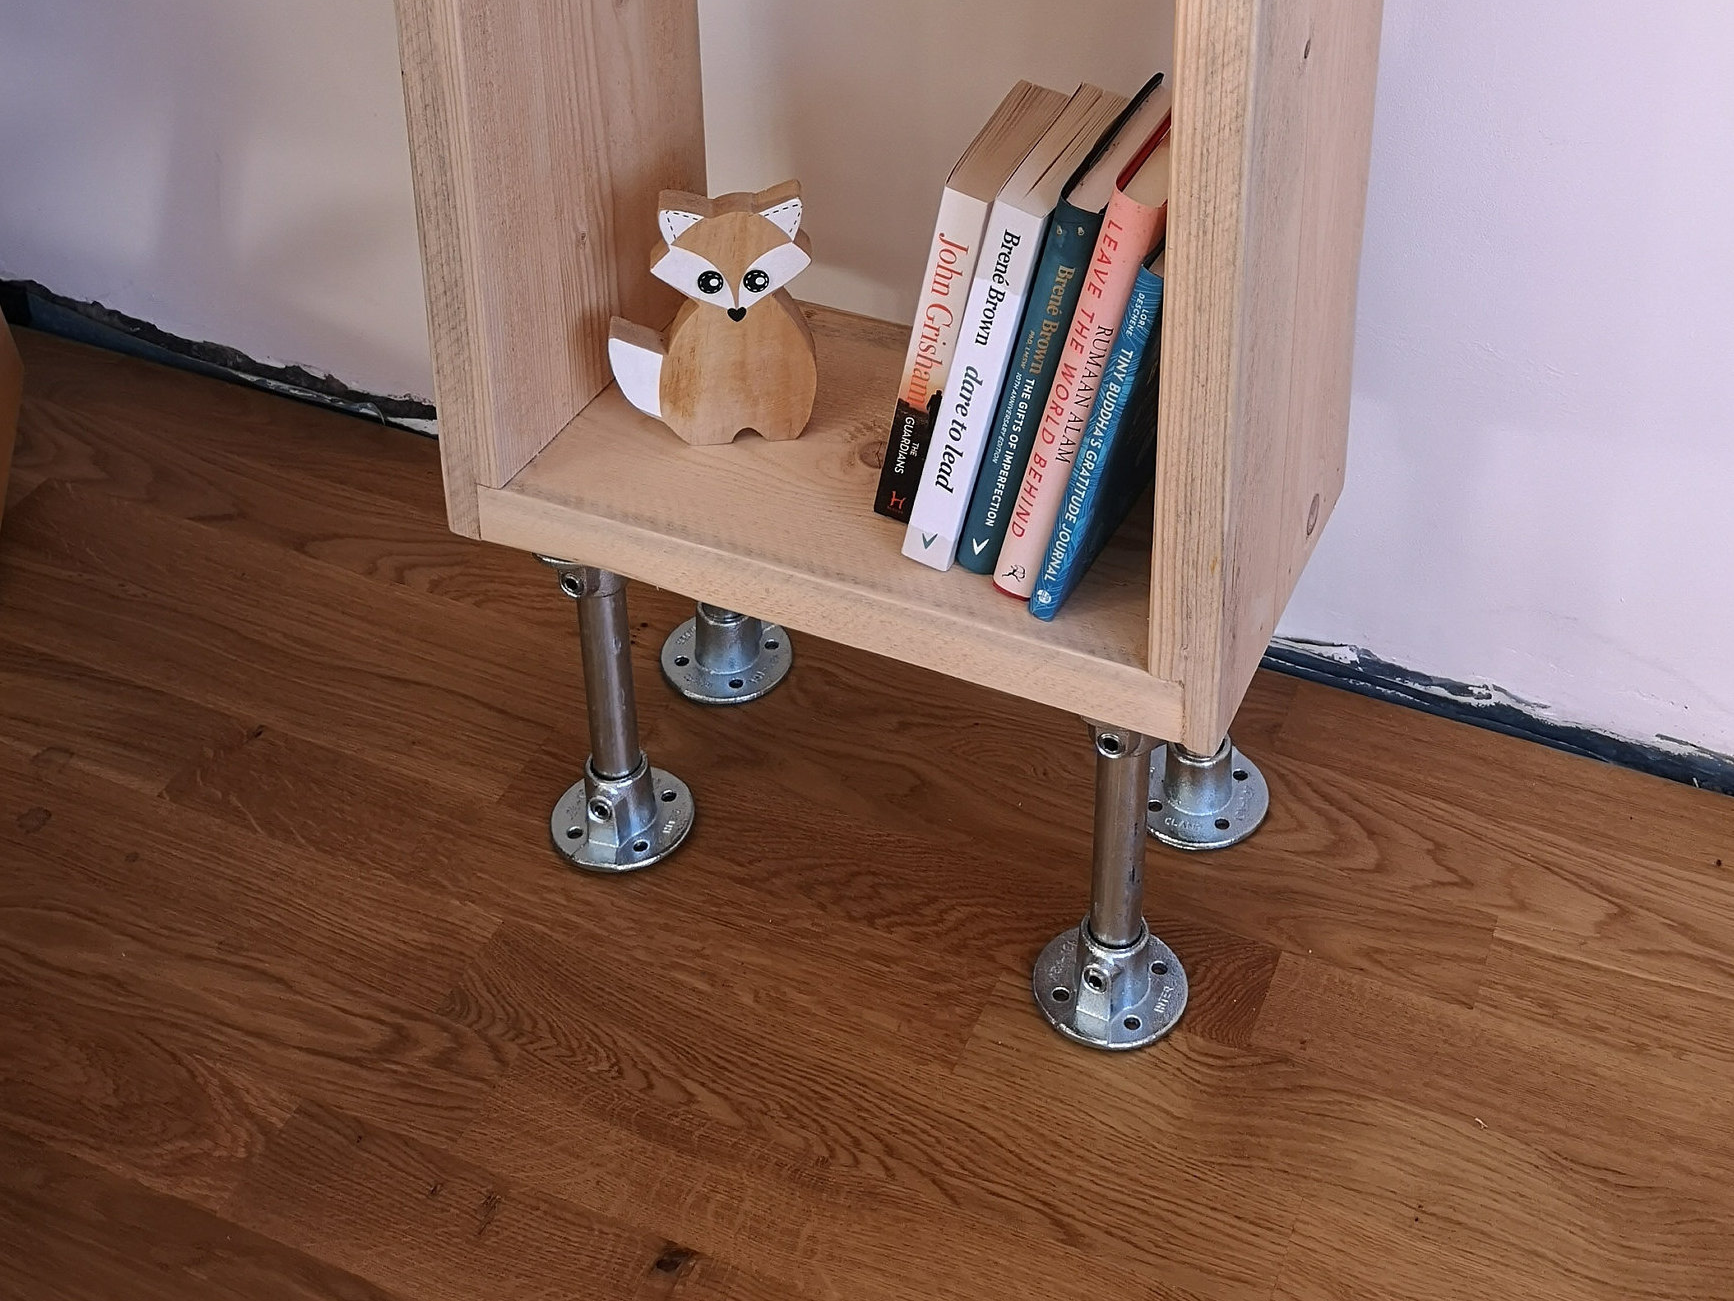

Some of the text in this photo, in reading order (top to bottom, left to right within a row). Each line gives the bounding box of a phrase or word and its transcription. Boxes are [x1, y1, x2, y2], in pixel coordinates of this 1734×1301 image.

[907, 232, 970, 405] John Grisham
[975, 229, 1022, 346] Brené Brown
[1029, 265, 1076, 375] Brené Brown
[1125, 292, 1146, 337] DESCHENE
[1137, 308, 1149, 329] LORI
[1011, 219, 1123, 538] LEAVE THE WORLD BEHIND
[1056, 324, 1114, 465] RUMAAN ALAM
[1113, 348, 1134, 382] TINY
[894, 416, 916, 475] GUARDIANS
[909, 442, 920, 457] THE
[935, 365, 983, 494] dare to lead
[985, 377, 1035, 527] THE GIFTS OF IMPERFECTION
[992, 372, 1023, 465] 10TH ANNIVERSARY EDITION
[1090, 382, 1122, 449] BUDDHA'S
[1065, 448, 1099, 524] GRATITUDE
[1044, 523, 1073, 582] JOURNAL
